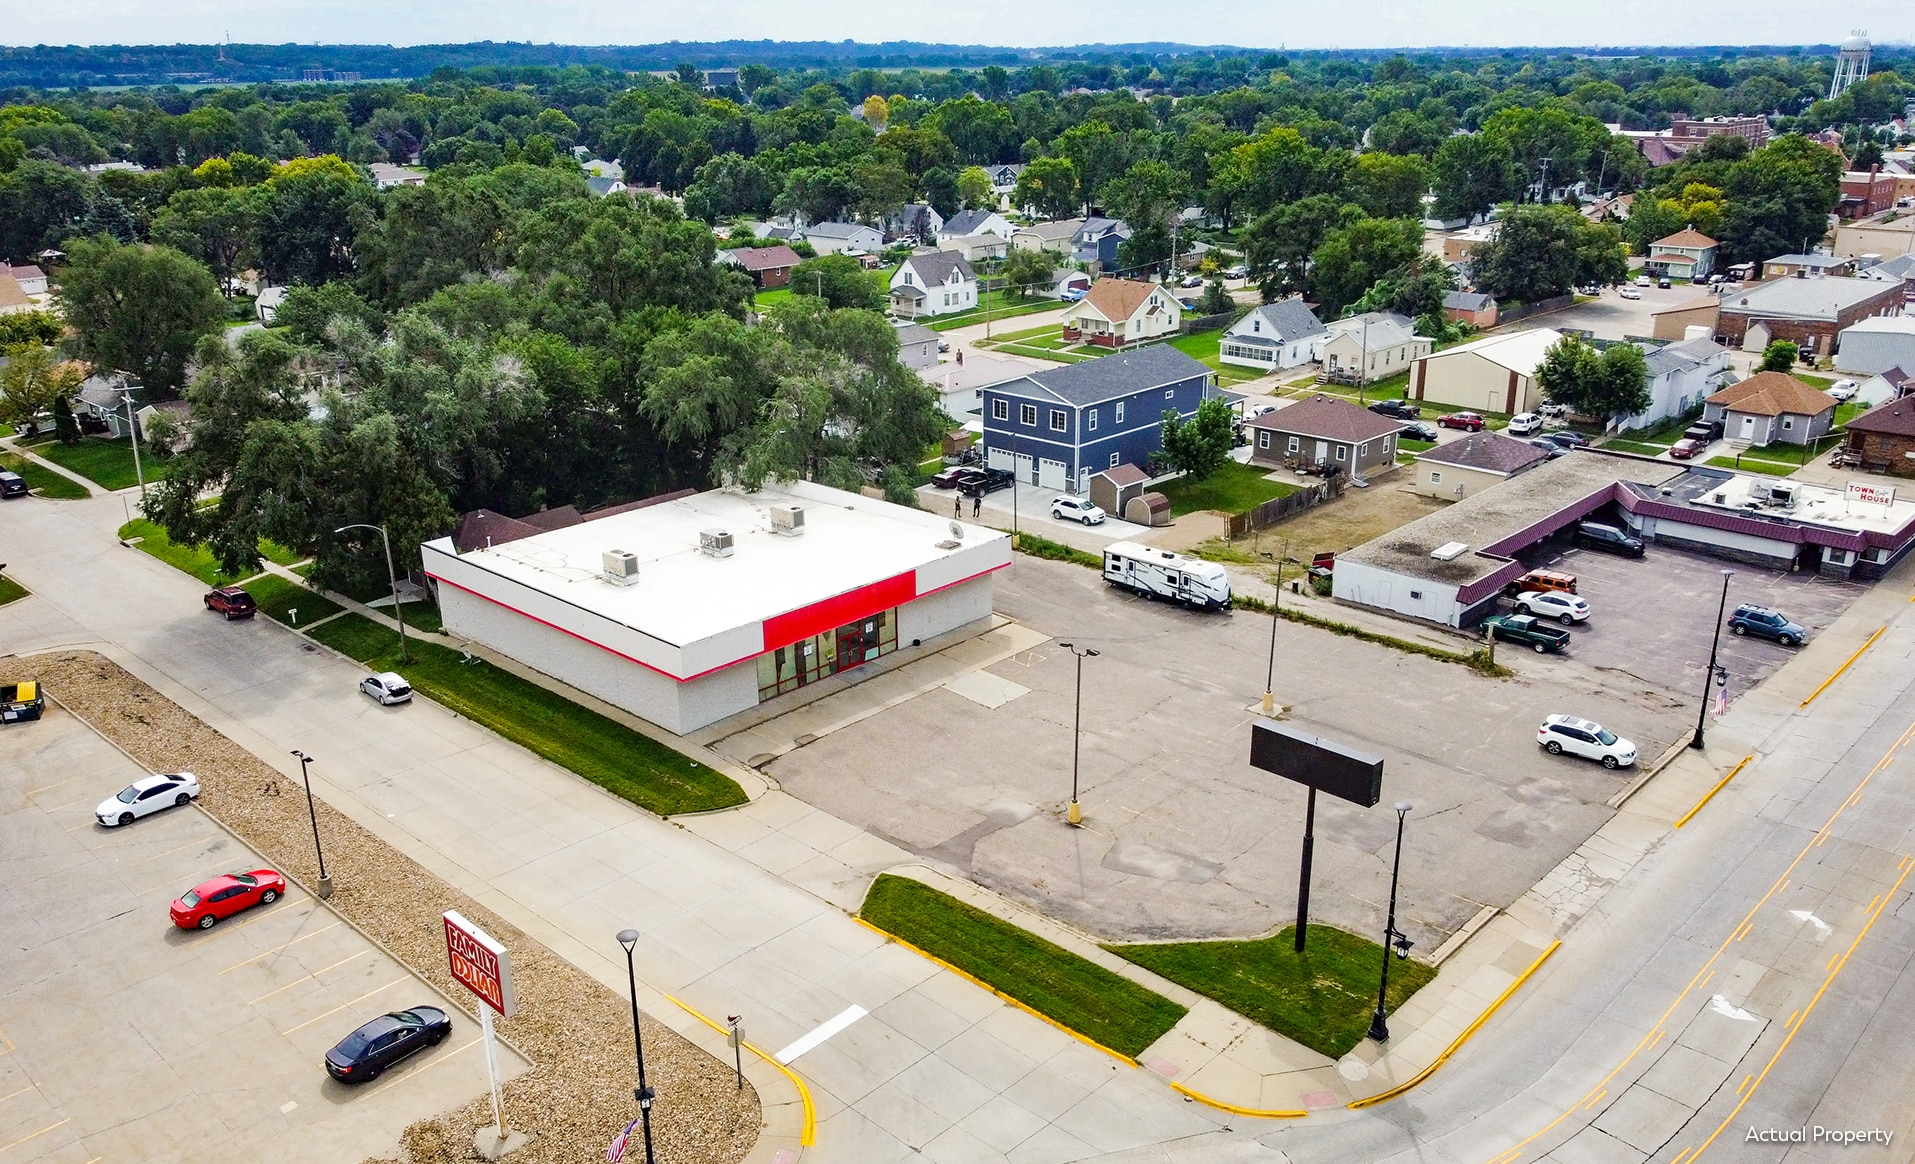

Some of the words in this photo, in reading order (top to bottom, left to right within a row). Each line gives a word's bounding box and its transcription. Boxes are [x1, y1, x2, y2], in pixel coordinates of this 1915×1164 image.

[1849, 485, 1875, 494] TOWN
[1860, 493, 1890, 504] HOUSE
[447, 923, 496, 980] FAMILY
[451, 951, 501, 1007] DOLLAR
